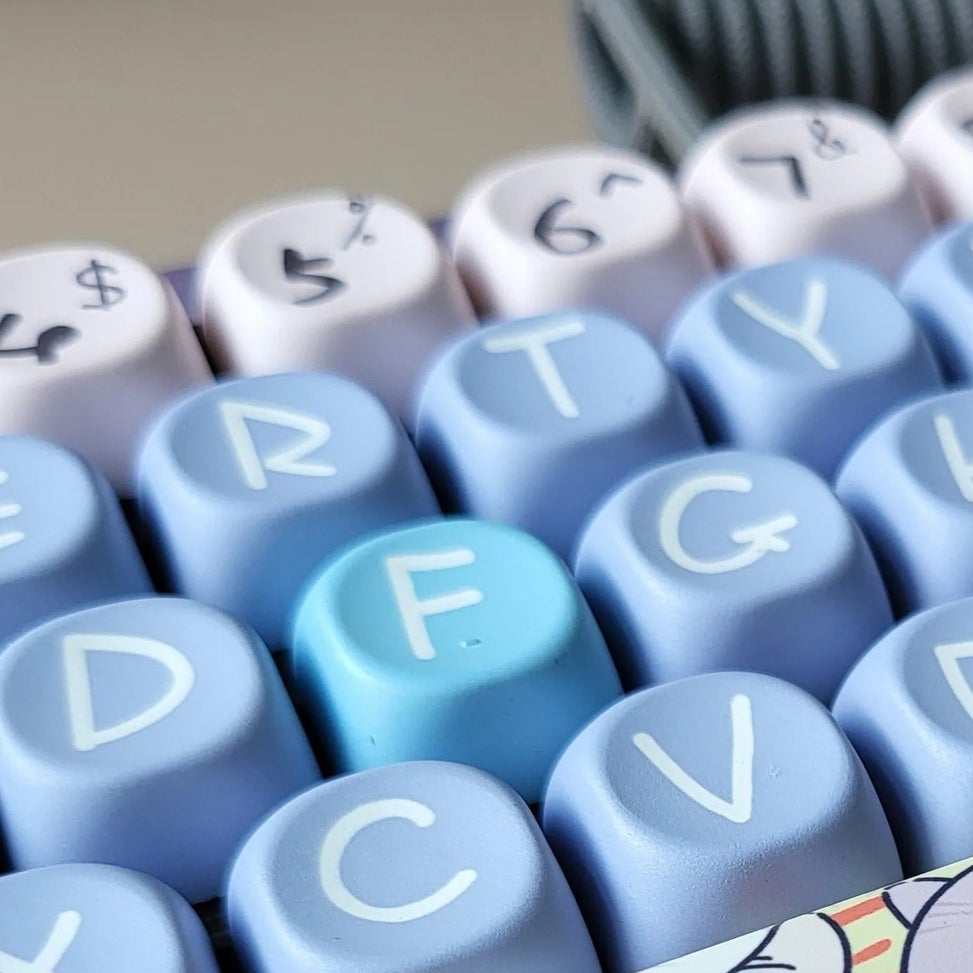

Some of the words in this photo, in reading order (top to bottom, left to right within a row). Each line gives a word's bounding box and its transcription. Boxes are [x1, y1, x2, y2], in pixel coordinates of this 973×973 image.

[740, 155, 811, 201] 7
[533, 199, 602, 256] 6
[75, 258, 128, 312] $
[282, 247, 346, 308] 5
[485, 318, 587, 419] T
[731, 280, 841, 370] Y
[219, 400, 338, 490] R
[658, 475, 798, 574] G
[385, 549, 484, 660] F
[64, 634, 195, 751] D
[632, 694, 753, 823] V
[319, 798, 478, 923] C
